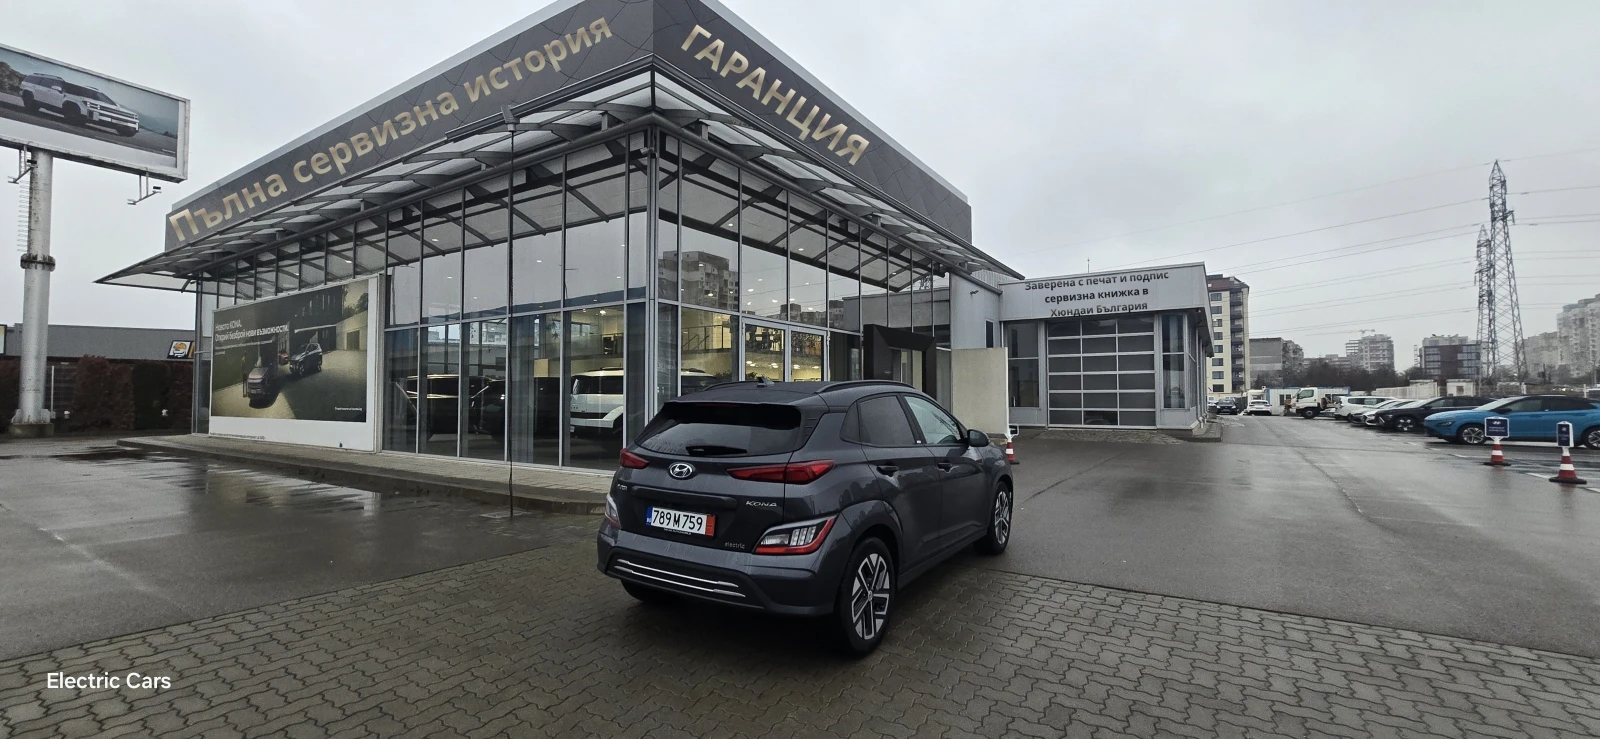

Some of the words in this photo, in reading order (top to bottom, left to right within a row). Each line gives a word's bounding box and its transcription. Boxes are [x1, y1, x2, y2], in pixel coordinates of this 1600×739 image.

[680, 24, 870, 166] ГАРАНЦИЯ
[168, 173, 288, 242] Пълна
[293, 89, 459, 184] сервизна
[463, 17, 613, 102] история
[1025, 279, 1076, 291] Заверена
[1078, 278, 1084, 286] с
[1086, 276, 1117, 285] печат
[1120, 275, 1127, 283] и
[1129, 271, 1169, 283] подпис
[1045, 292, 1095, 304] сервизна
[1097, 289, 1139, 299] книжка
[1096, 302, 1148, 315] България
